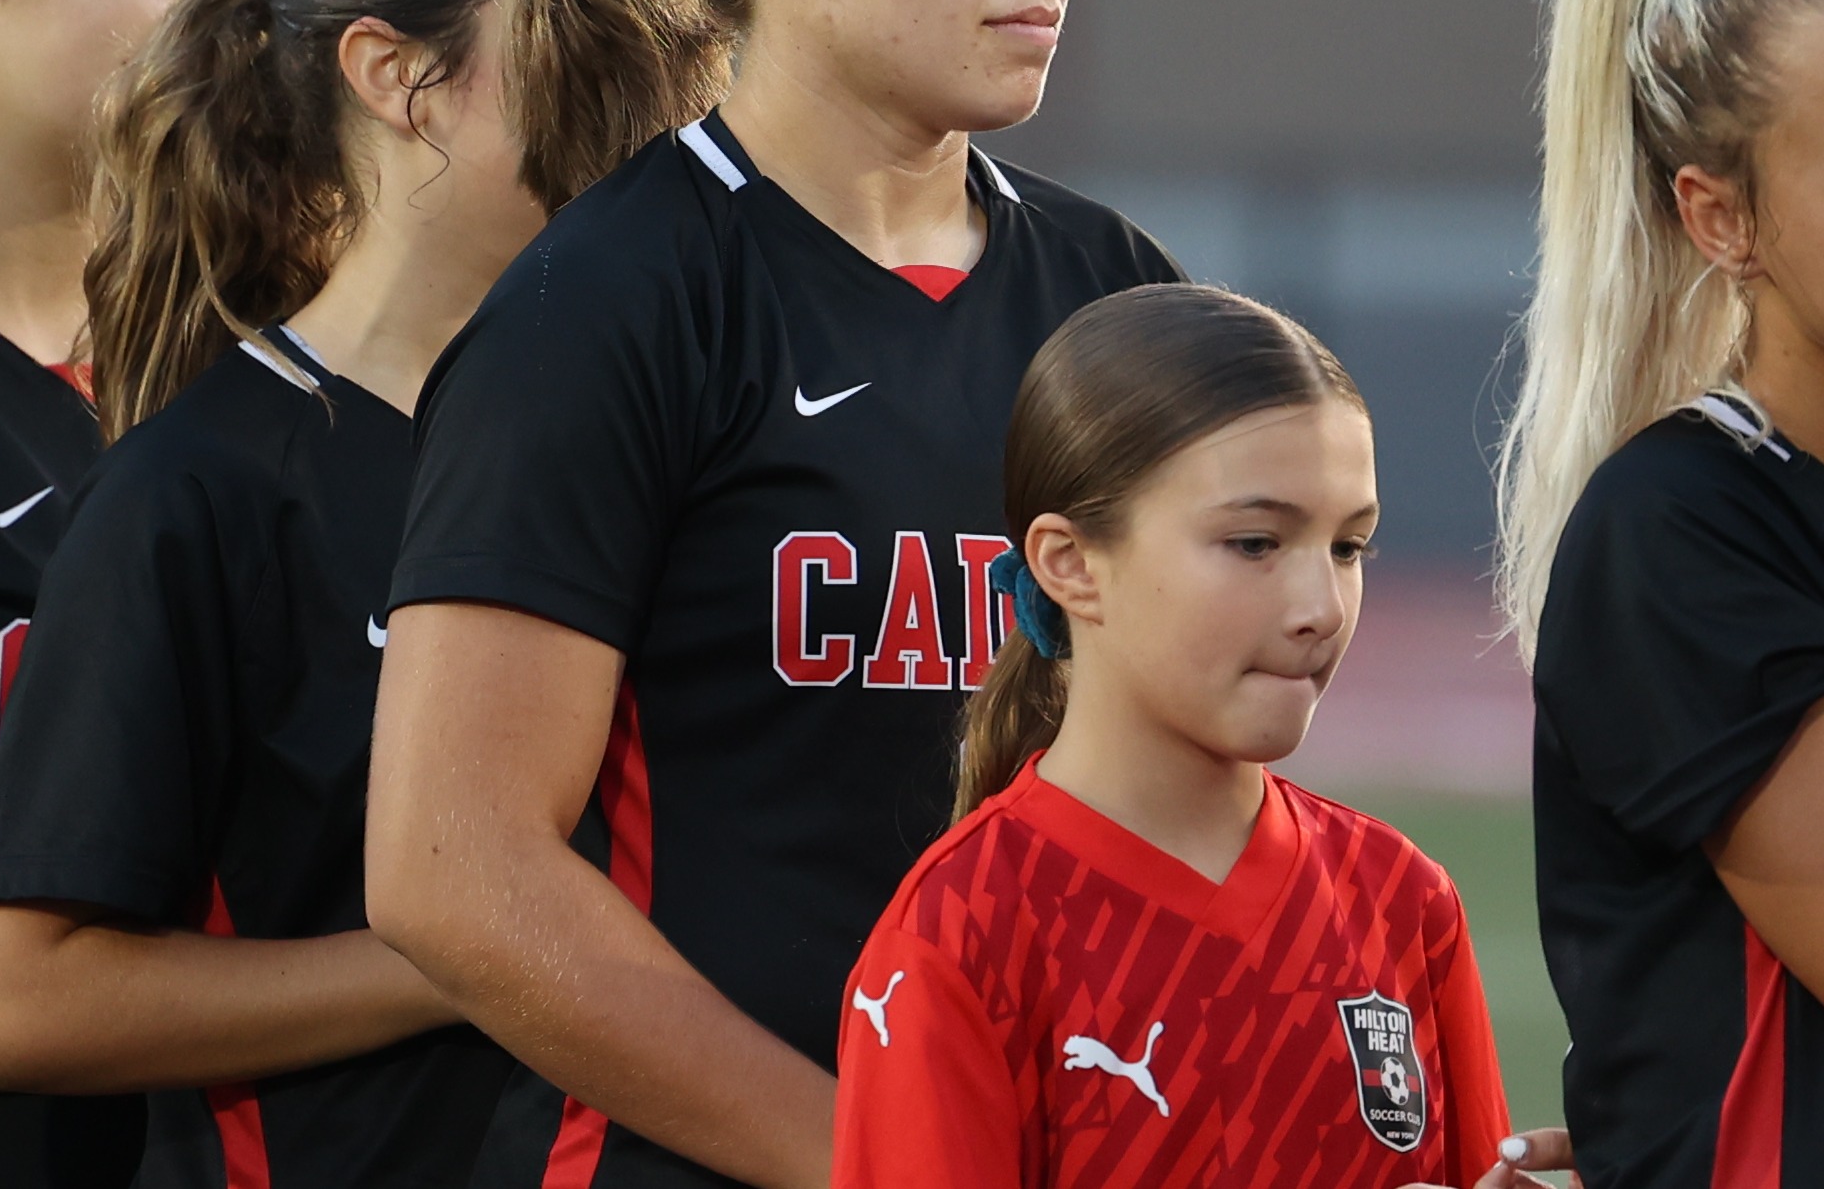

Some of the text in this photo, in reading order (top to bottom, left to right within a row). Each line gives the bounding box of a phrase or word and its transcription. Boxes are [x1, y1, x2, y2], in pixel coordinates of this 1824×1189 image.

[1354, 1009, 1406, 1034] HILTON
[1368, 1030, 1404, 1054] HEAT
[1369, 1109, 1421, 1126] SOCCER CLUB
[1386, 1131, 1400, 1139] NEW
